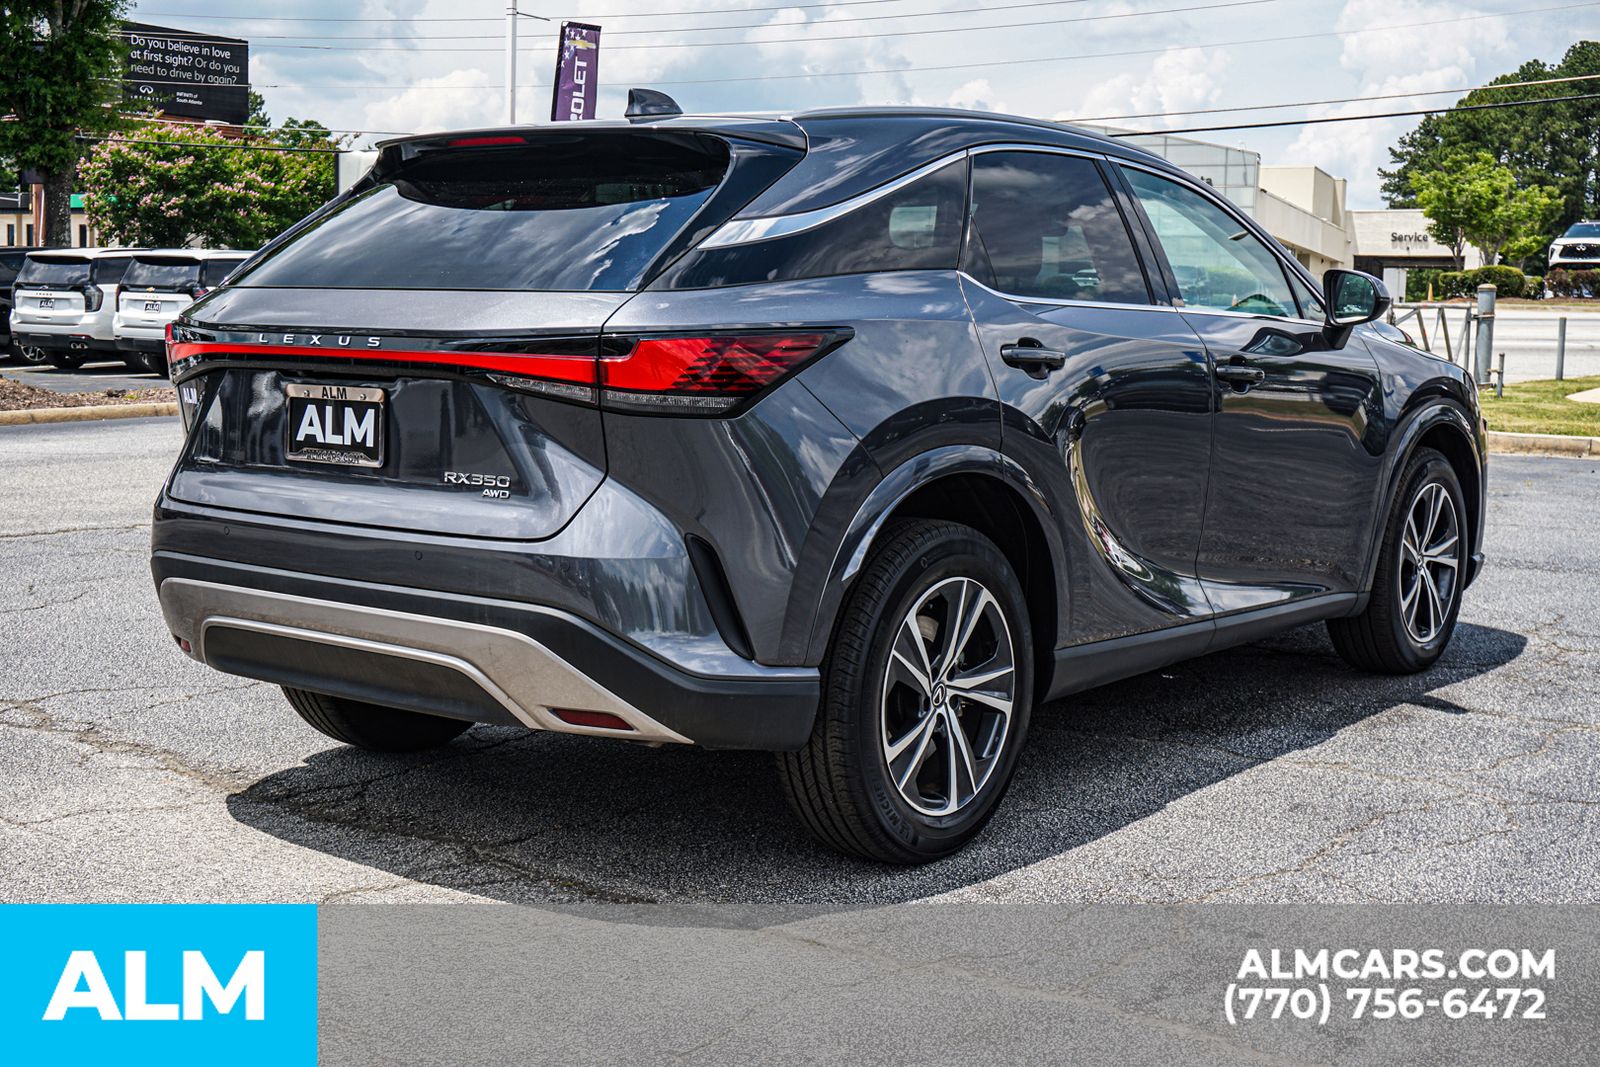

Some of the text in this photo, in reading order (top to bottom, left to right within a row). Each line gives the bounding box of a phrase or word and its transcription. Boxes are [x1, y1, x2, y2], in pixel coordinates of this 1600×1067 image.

[130, 34, 231, 59] Do you believe in love
[130, 49, 240, 74] at first sight? Or do you
[130, 63, 238, 85] need to drive by again?
[1391, 231, 1429, 242] Service
[259, 333, 381, 347] LEXUS
[321, 386, 347, 400] ALM
[296, 404, 375, 448] ALM
[481, 488, 510, 499] AWD
